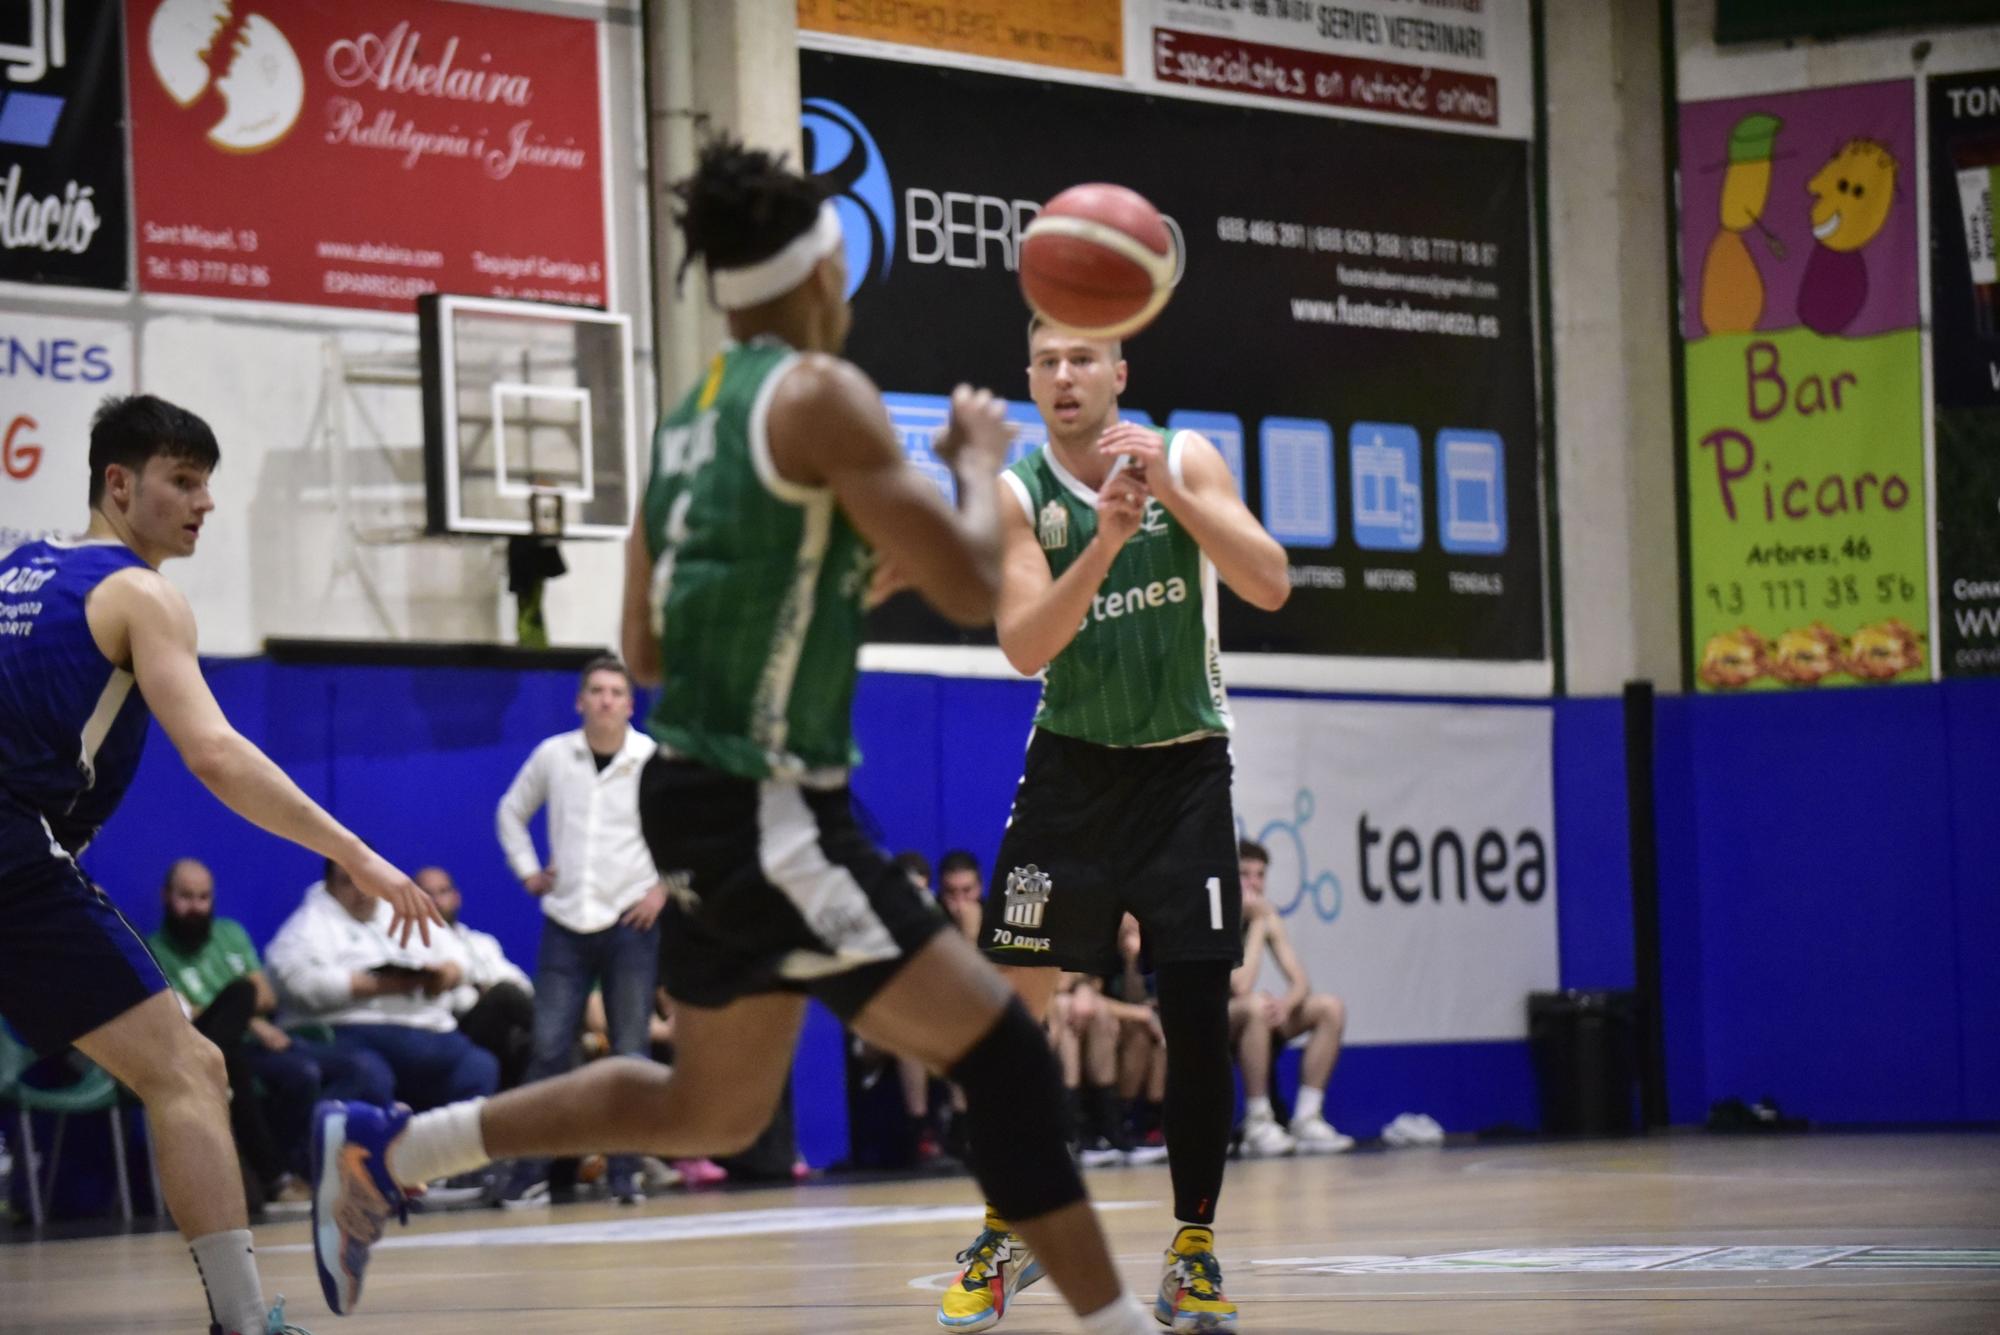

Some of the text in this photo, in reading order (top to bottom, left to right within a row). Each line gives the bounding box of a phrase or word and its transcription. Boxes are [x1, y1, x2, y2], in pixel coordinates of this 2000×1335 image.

[1317, 5, 1382, 44] SERVEI
[1384, 16, 1486, 57] VETERINARI
[325, 20, 532, 107] Abelaira
[1155, 32, 1307, 94] Especialistes
[1314, 70, 1345, 97] en
[0, 338, 113, 382] NES
[1744, 341, 1857, 421] Bar
[1700, 428, 1909, 523] Picaro
[1093, 576, 1187, 622] tenea
[1363, 567, 1417, 592] MOTORS
[1358, 810, 1548, 906] tenea
[1205, 876, 1224, 931] 1
[992, 928, 1052, 953] 70 anys
